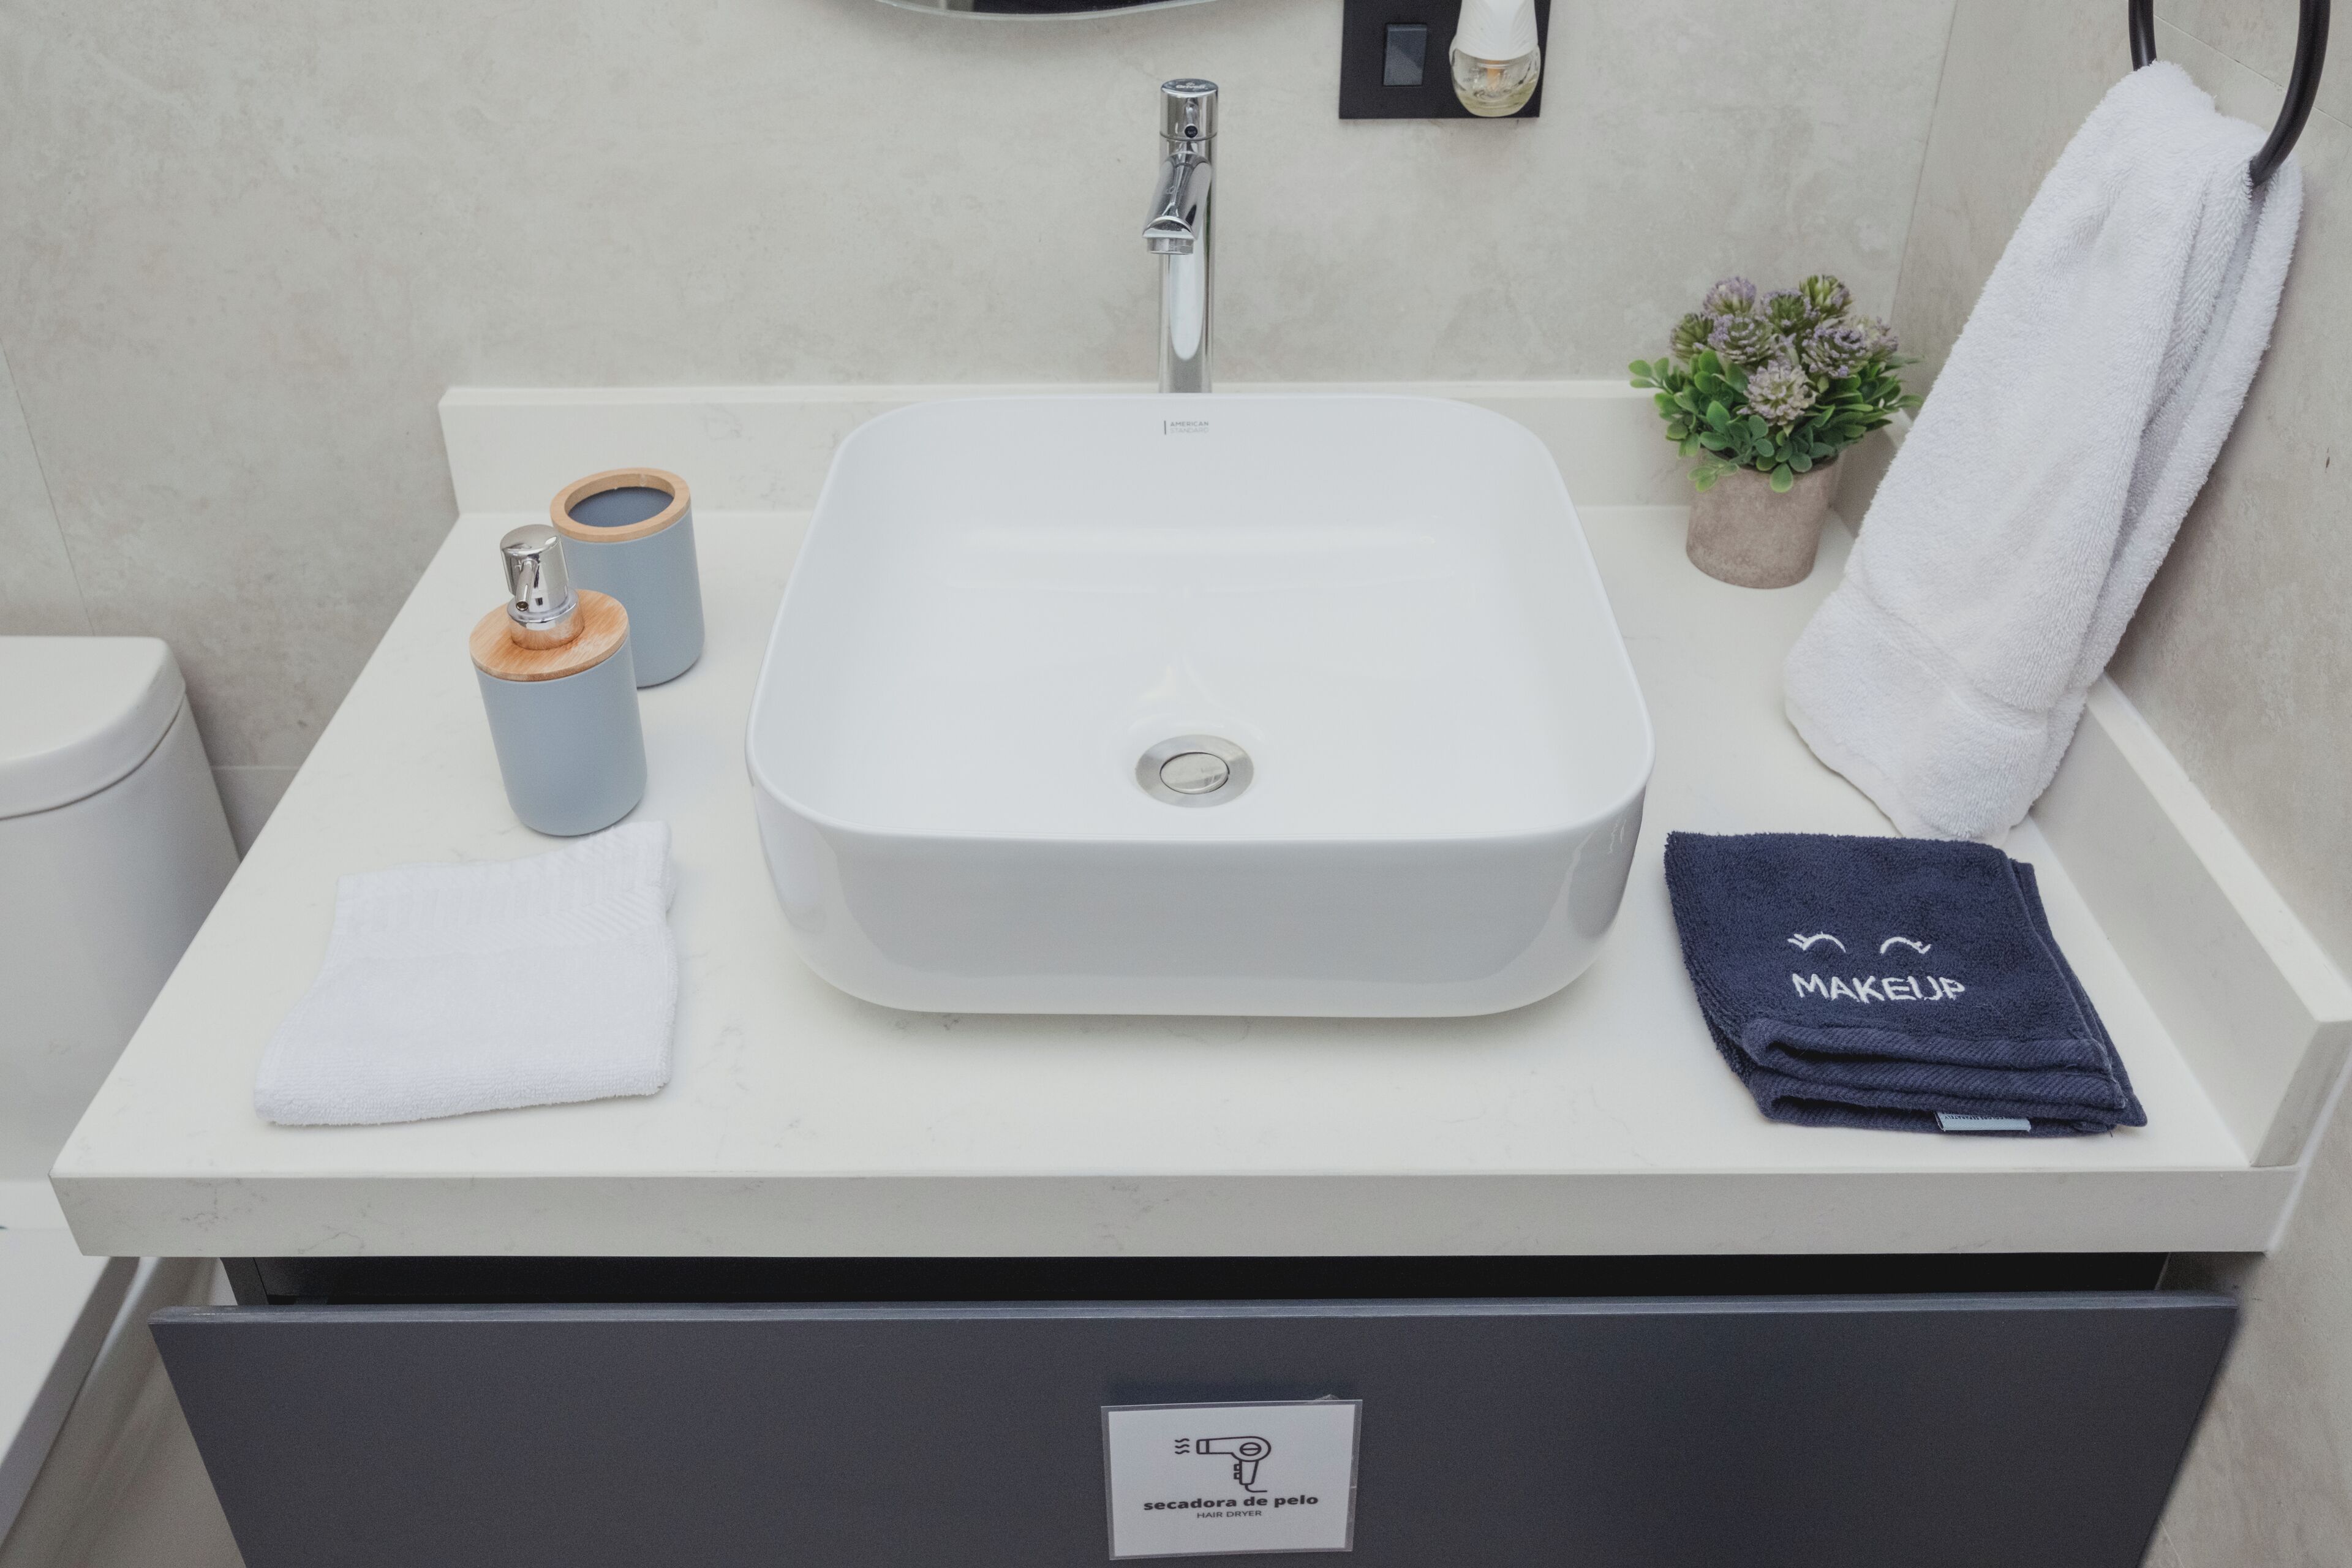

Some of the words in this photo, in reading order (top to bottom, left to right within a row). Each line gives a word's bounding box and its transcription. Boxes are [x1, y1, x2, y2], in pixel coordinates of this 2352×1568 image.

[1792, 973, 1966, 1004] MAKEUP
[1144, 1498, 1237, 1510] secadora
[1243, 1496, 1268, 1507] de
[1274, 1494, 1318, 1508] pelo
